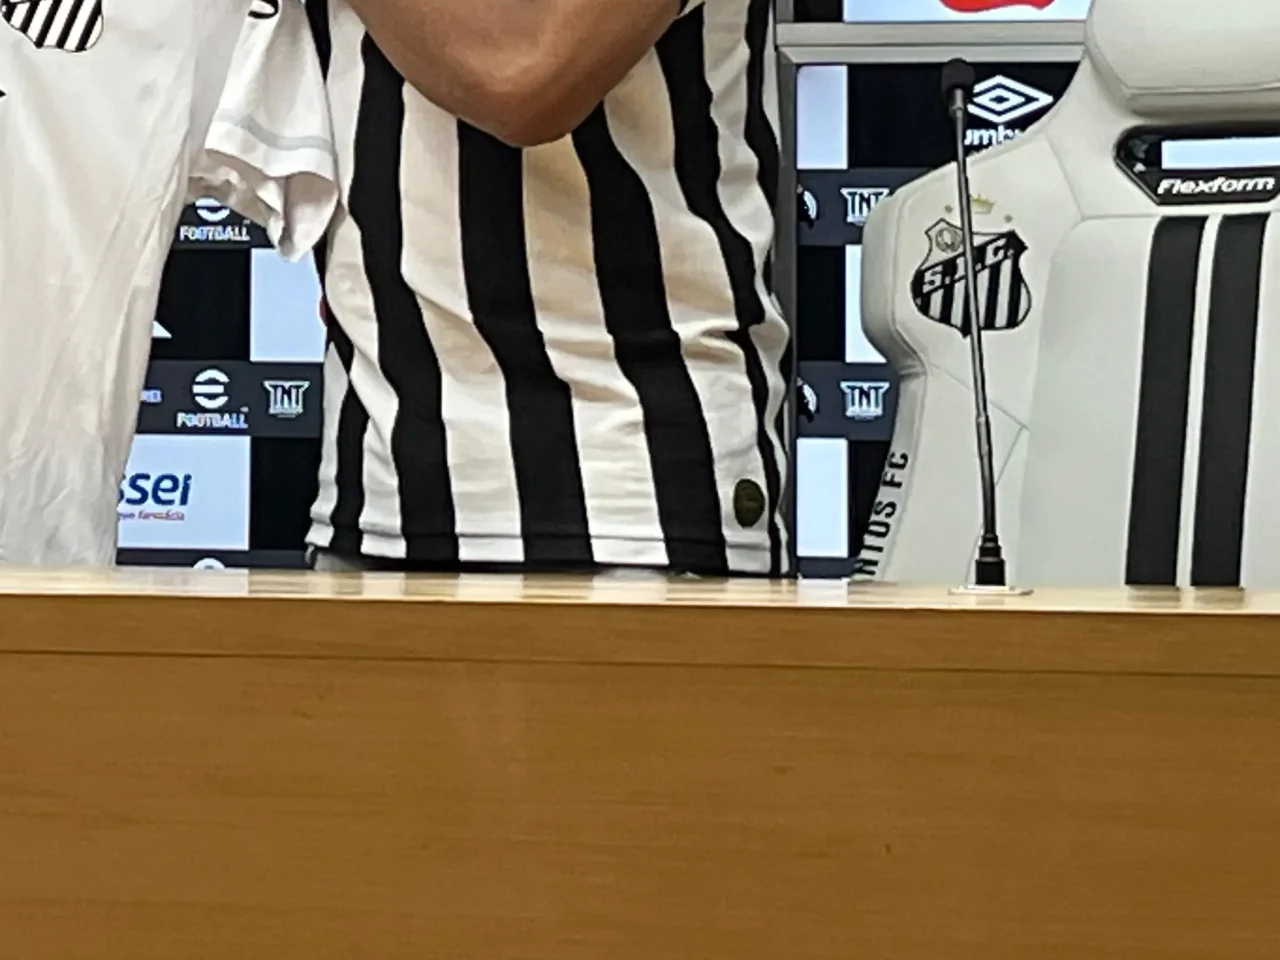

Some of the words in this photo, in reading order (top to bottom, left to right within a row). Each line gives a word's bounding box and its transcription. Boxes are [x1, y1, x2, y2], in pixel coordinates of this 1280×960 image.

[1156, 176, 1276, 196] Flexform
[179, 224, 251, 242] FOOTBALL
[176, 412, 248, 429] FOOTBALL
